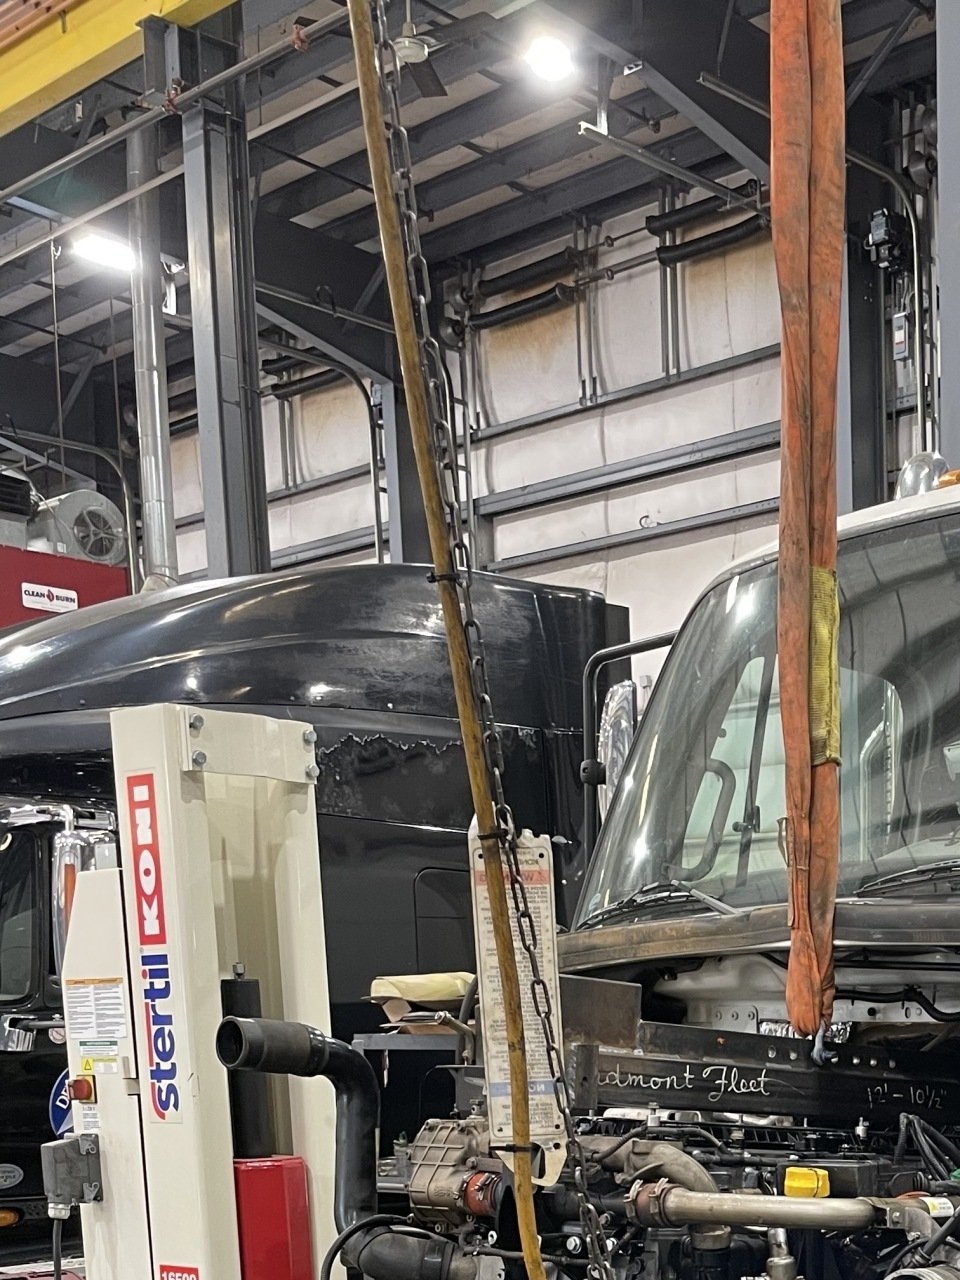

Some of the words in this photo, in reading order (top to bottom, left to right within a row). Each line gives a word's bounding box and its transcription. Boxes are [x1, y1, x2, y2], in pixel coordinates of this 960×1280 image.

[24, 589, 46, 599] CLEAN
[55, 594, 76, 604] BURN
[133, 785, 160, 936] KONI
[141, 953, 180, 1113] stertil
[702, 1066, 771, 1102] Fleet
